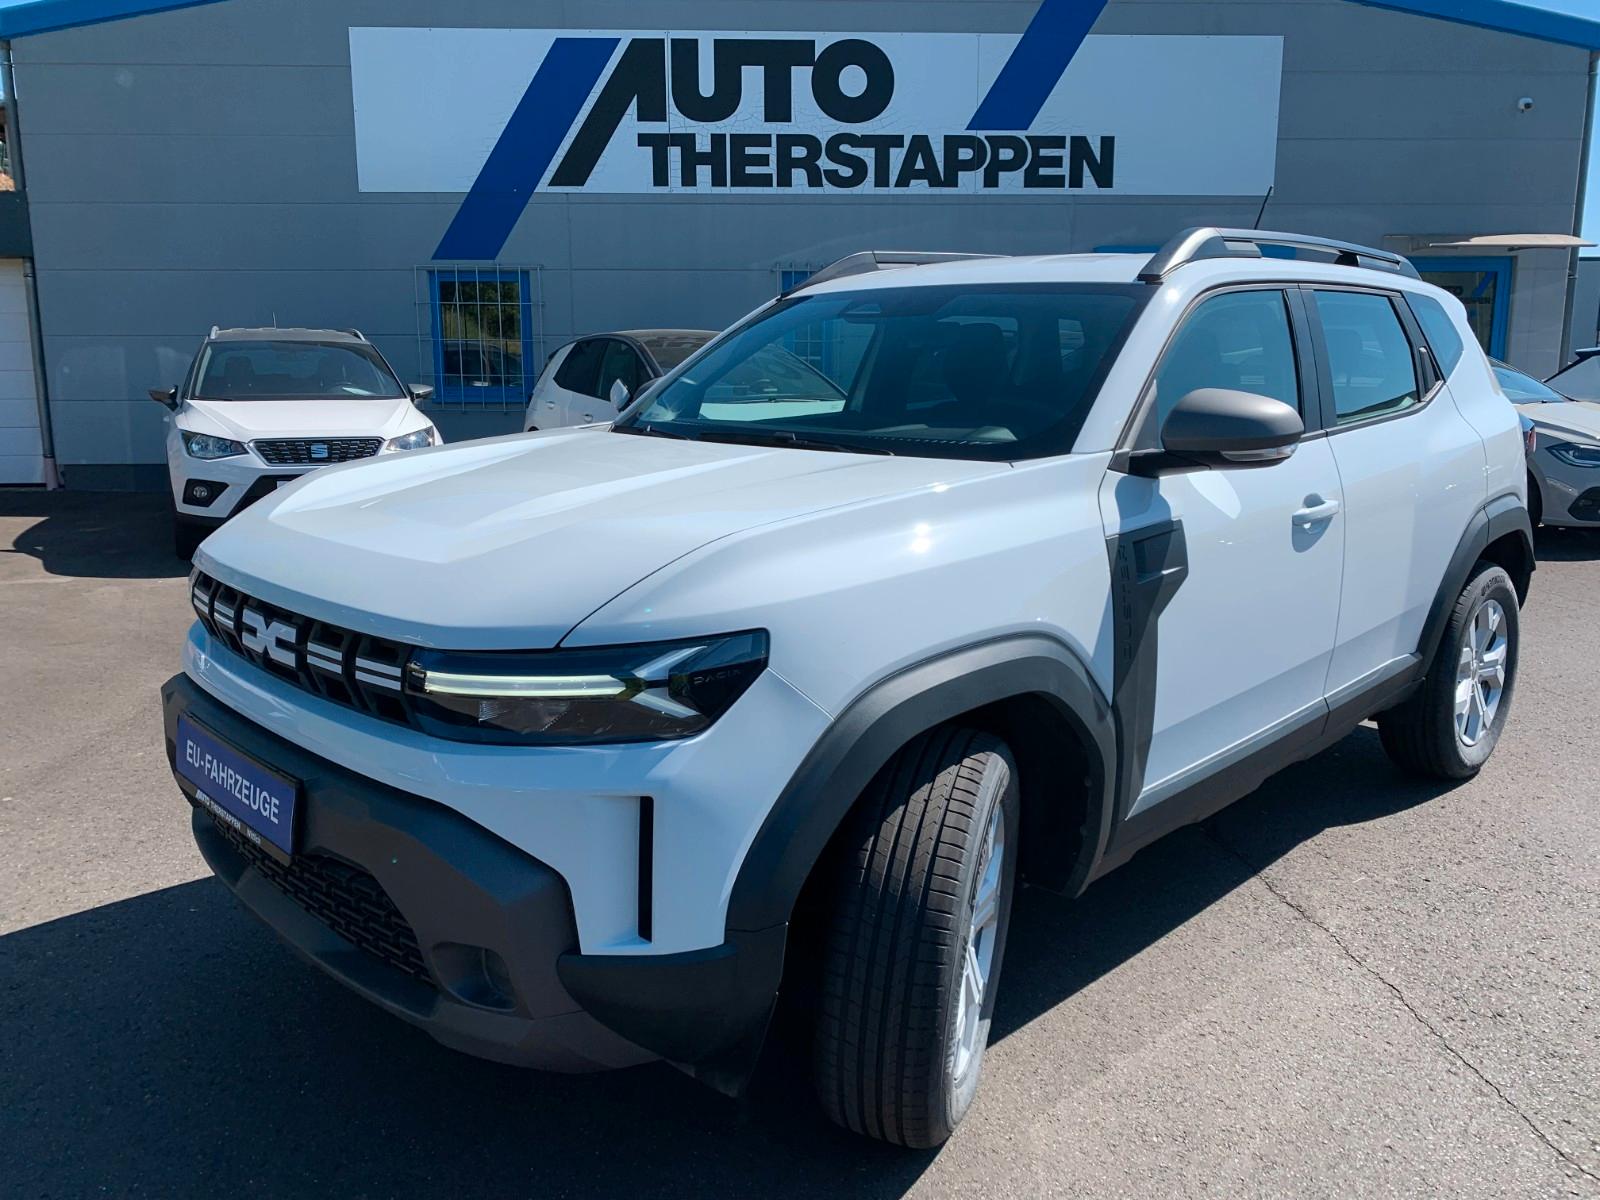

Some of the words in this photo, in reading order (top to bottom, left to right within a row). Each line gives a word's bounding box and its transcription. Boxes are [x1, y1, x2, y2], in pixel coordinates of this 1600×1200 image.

[548, 38, 895, 187] AUTO
[637, 132, 1115, 188] THERSTAPPEN
[186, 739, 280, 825] EU-FAHRZEUGE
